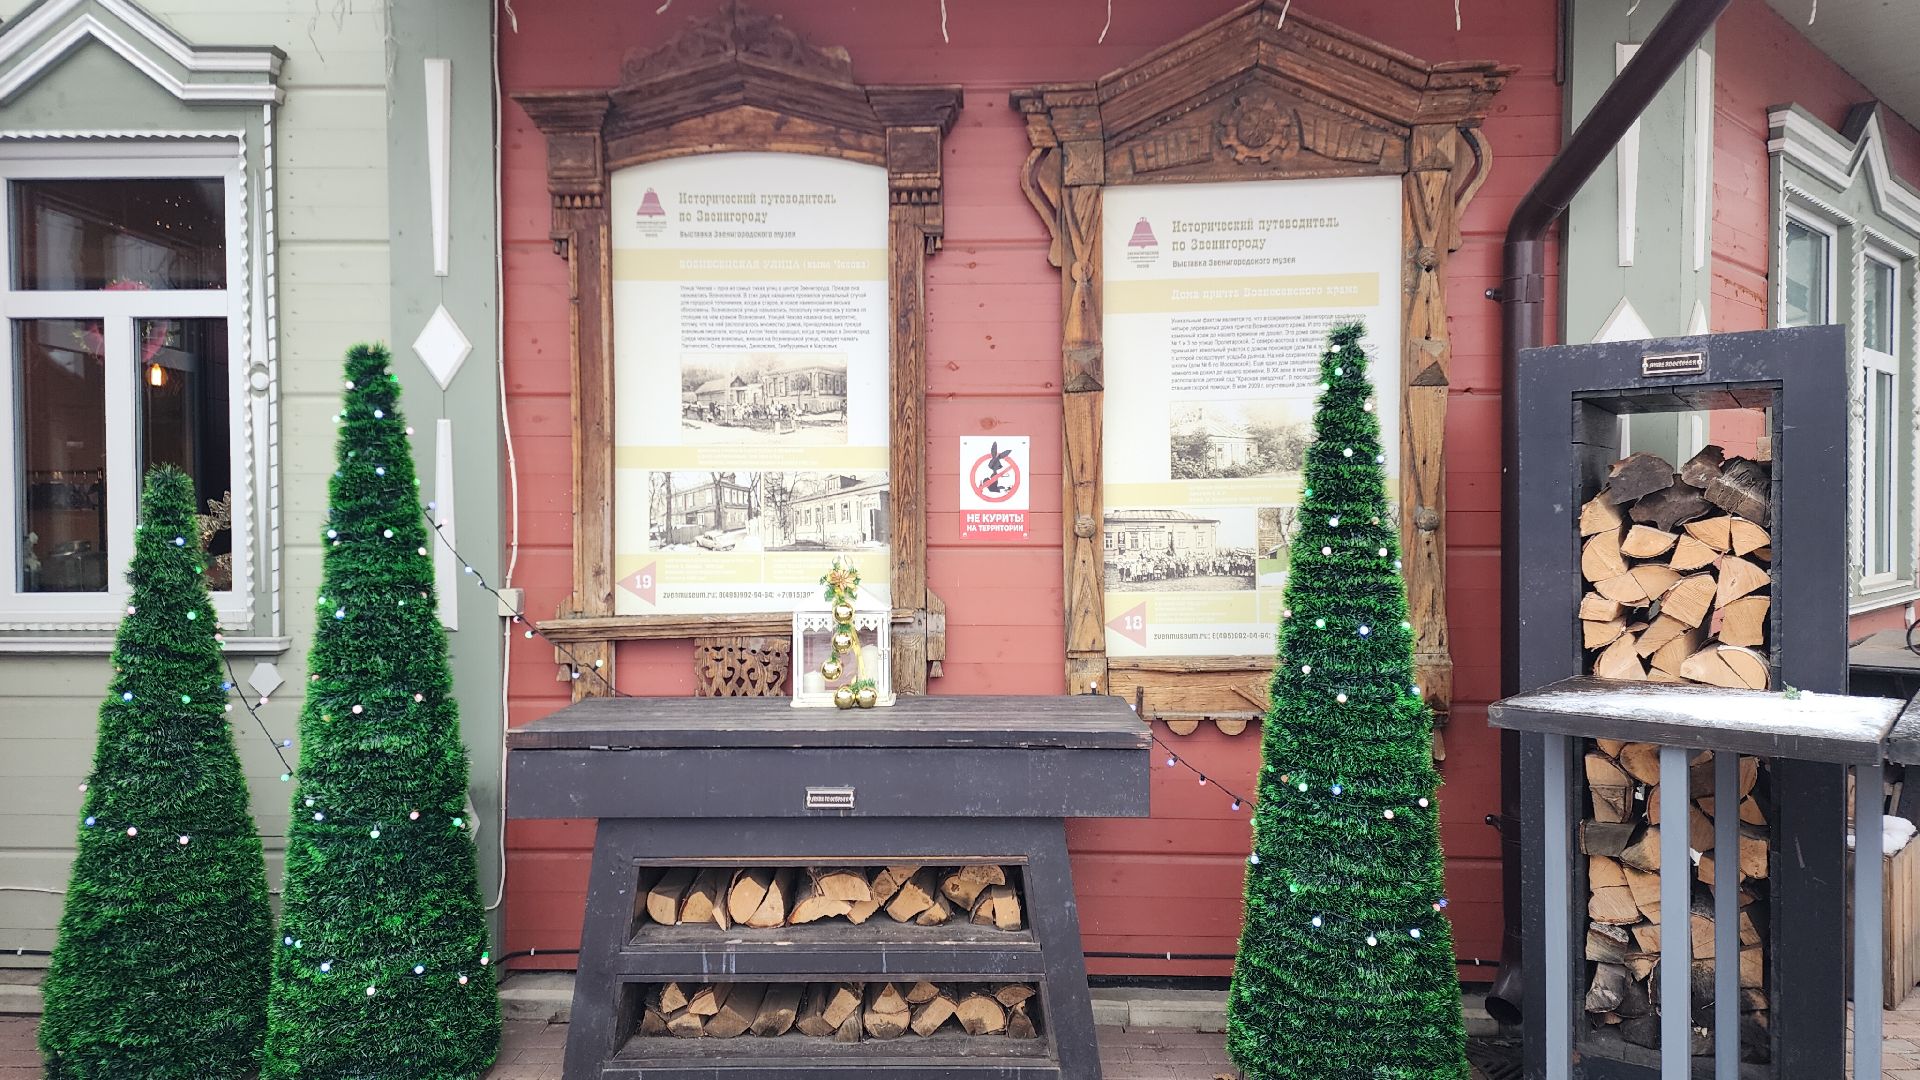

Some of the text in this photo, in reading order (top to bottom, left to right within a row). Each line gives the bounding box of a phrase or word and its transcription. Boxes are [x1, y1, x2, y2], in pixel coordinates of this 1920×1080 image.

[679, 192, 836, 206] Исторический путеводитель
[679, 210, 768, 224] по Звенигороду
[1172, 216, 1340, 233] Исторический путеводитель
[680, 231, 712, 239] Выставка
[1172, 238, 1266, 251] по Звенигороду
[1172, 260, 1207, 268] Выставка
[966, 514, 980, 522] НЕ
[636, 575, 652, 588] 19
[1124, 616, 1142, 630] 18
